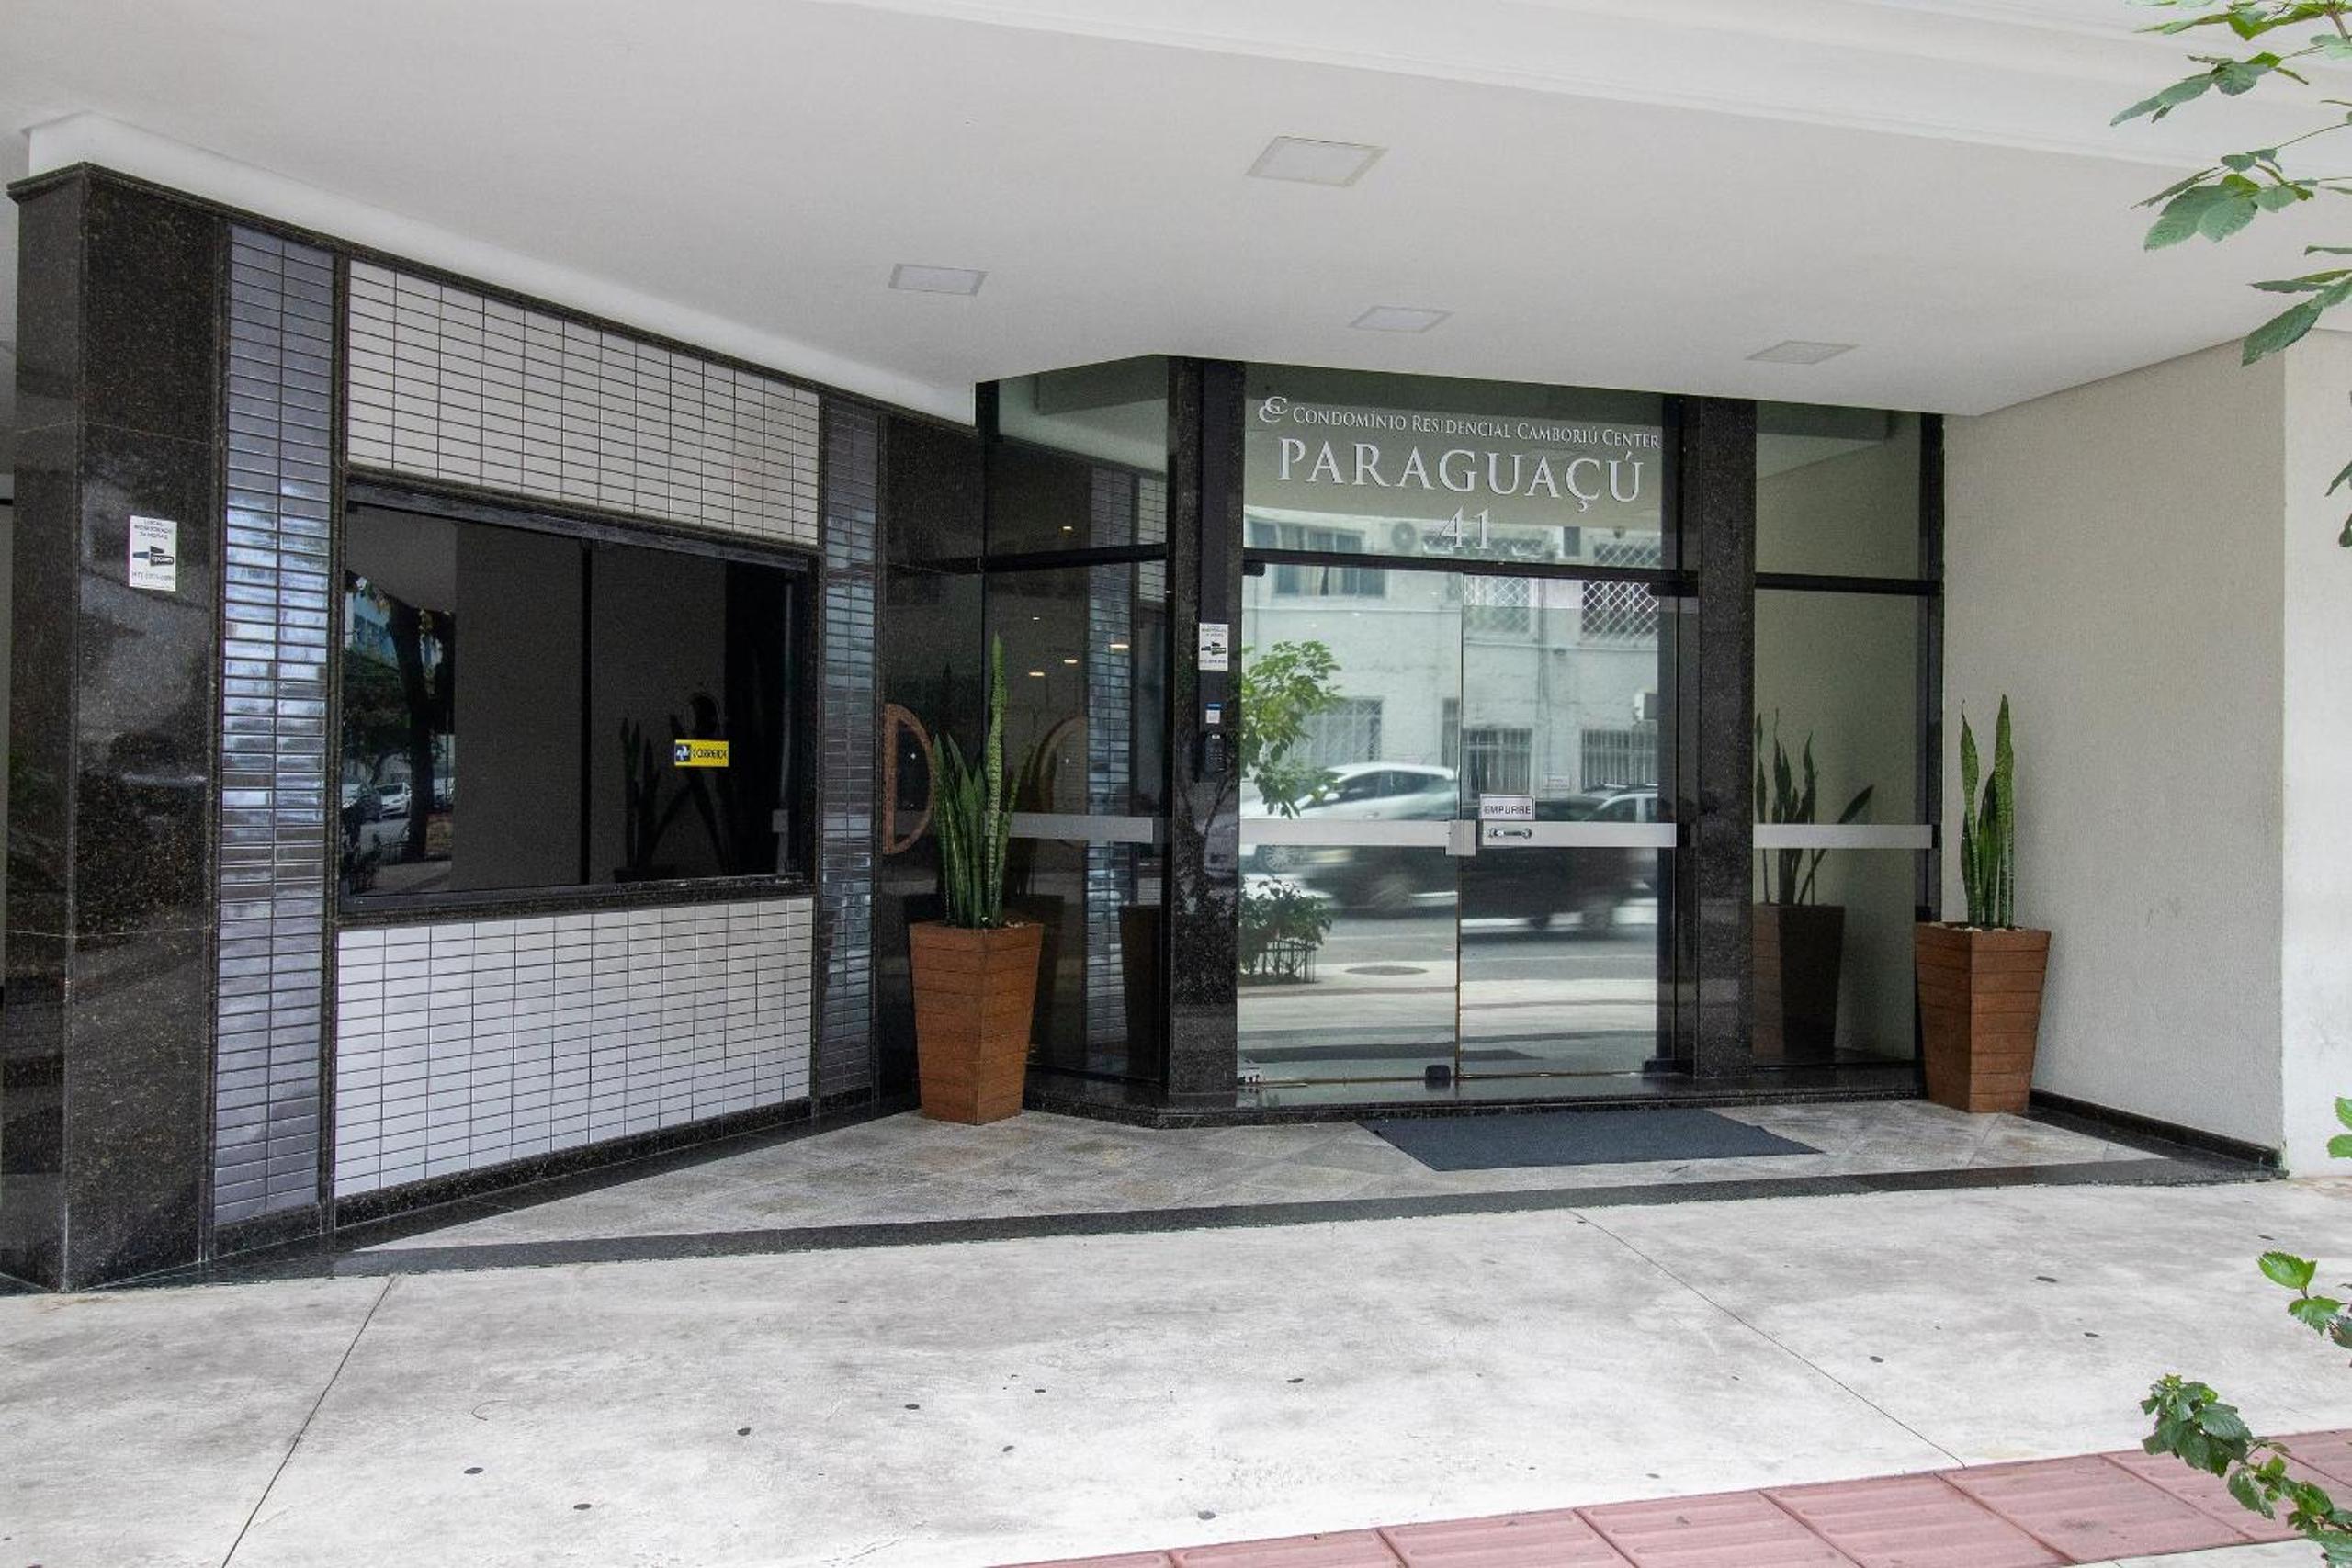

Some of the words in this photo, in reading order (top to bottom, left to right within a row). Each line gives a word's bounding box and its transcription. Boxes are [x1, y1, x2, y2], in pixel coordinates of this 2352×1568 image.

[1293, 406, 1406, 431] CONDOMÍNIO
[1412, 414, 1511, 439] RESIDENCIAL
[1517, 423, 1598, 444] CAMBORIÚ
[1602, 429, 1660, 449] CENTER
[1277, 436, 1645, 513] PARAGUAÇÚ
[1439, 505, 1490, 549] 41
[1484, 806, 1532, 815] EMPURRE
